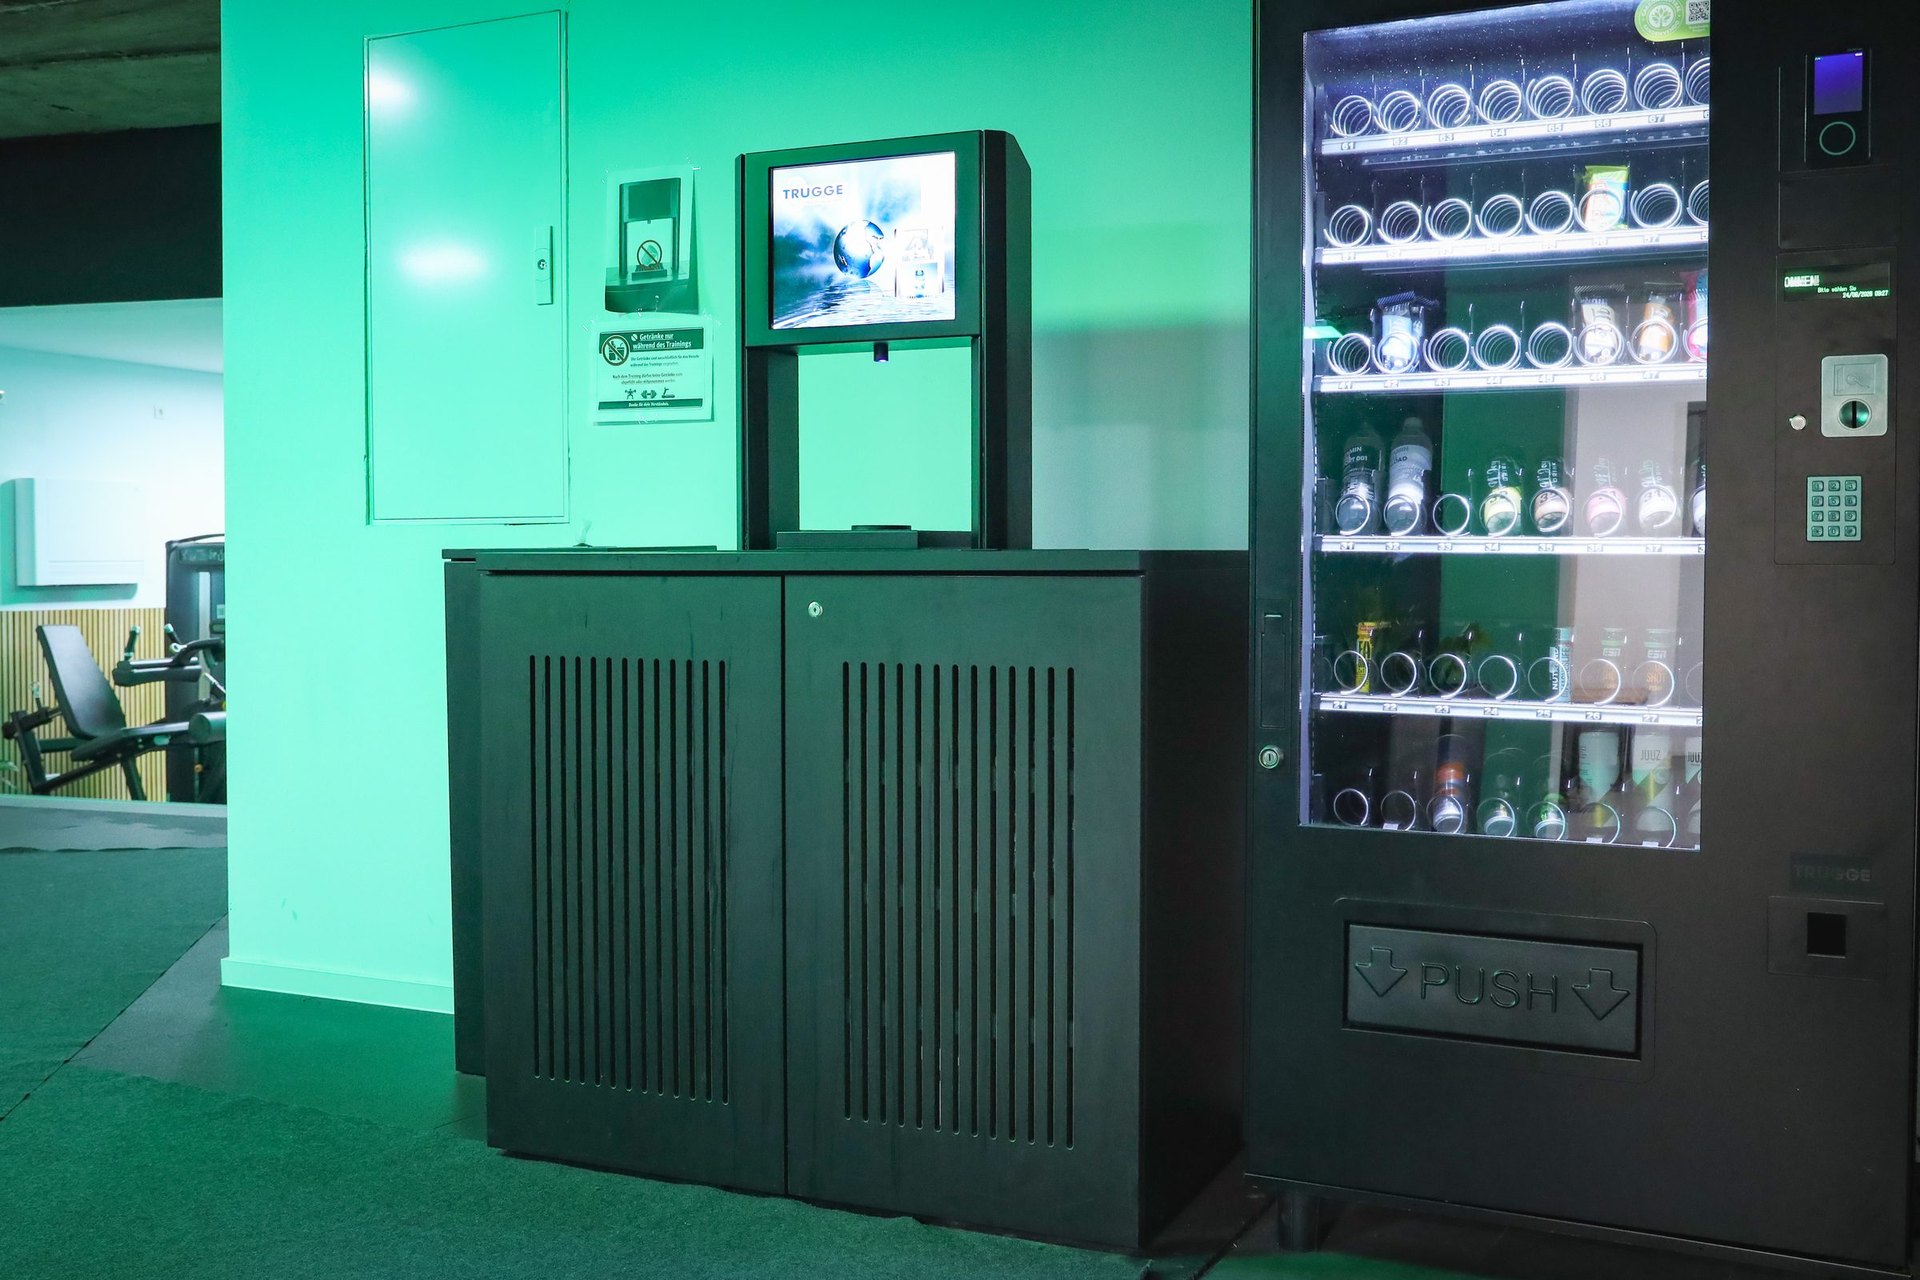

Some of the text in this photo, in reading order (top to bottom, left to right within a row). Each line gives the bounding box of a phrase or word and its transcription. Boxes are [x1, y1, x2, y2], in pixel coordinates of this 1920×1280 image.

[1649, 115, 1663, 123] 67
[1549, 124, 1561, 132] 65
[1440, 133, 1453, 141] 63
[1342, 142, 1355, 150] 61
[783, 184, 844, 199] TRUGGE
[639, 333, 664, 341] Getränke
[633, 342, 656, 350] während
[1386, 543, 1400, 551] 32
[1333, 701, 1346, 709] 21
[1383, 703, 1397, 711] 22
[1436, 705, 1450, 714] 23
[1484, 707, 1498, 715] 24
[1537, 710, 1551, 718] 25
[1586, 712, 1600, 720] 26
[1644, 714, 1659, 722] 27
[1640, 749, 1662, 761] JUUZ
[1793, 864, 1872, 882] TRGE
[1420, 961, 1558, 1013] PUSH
